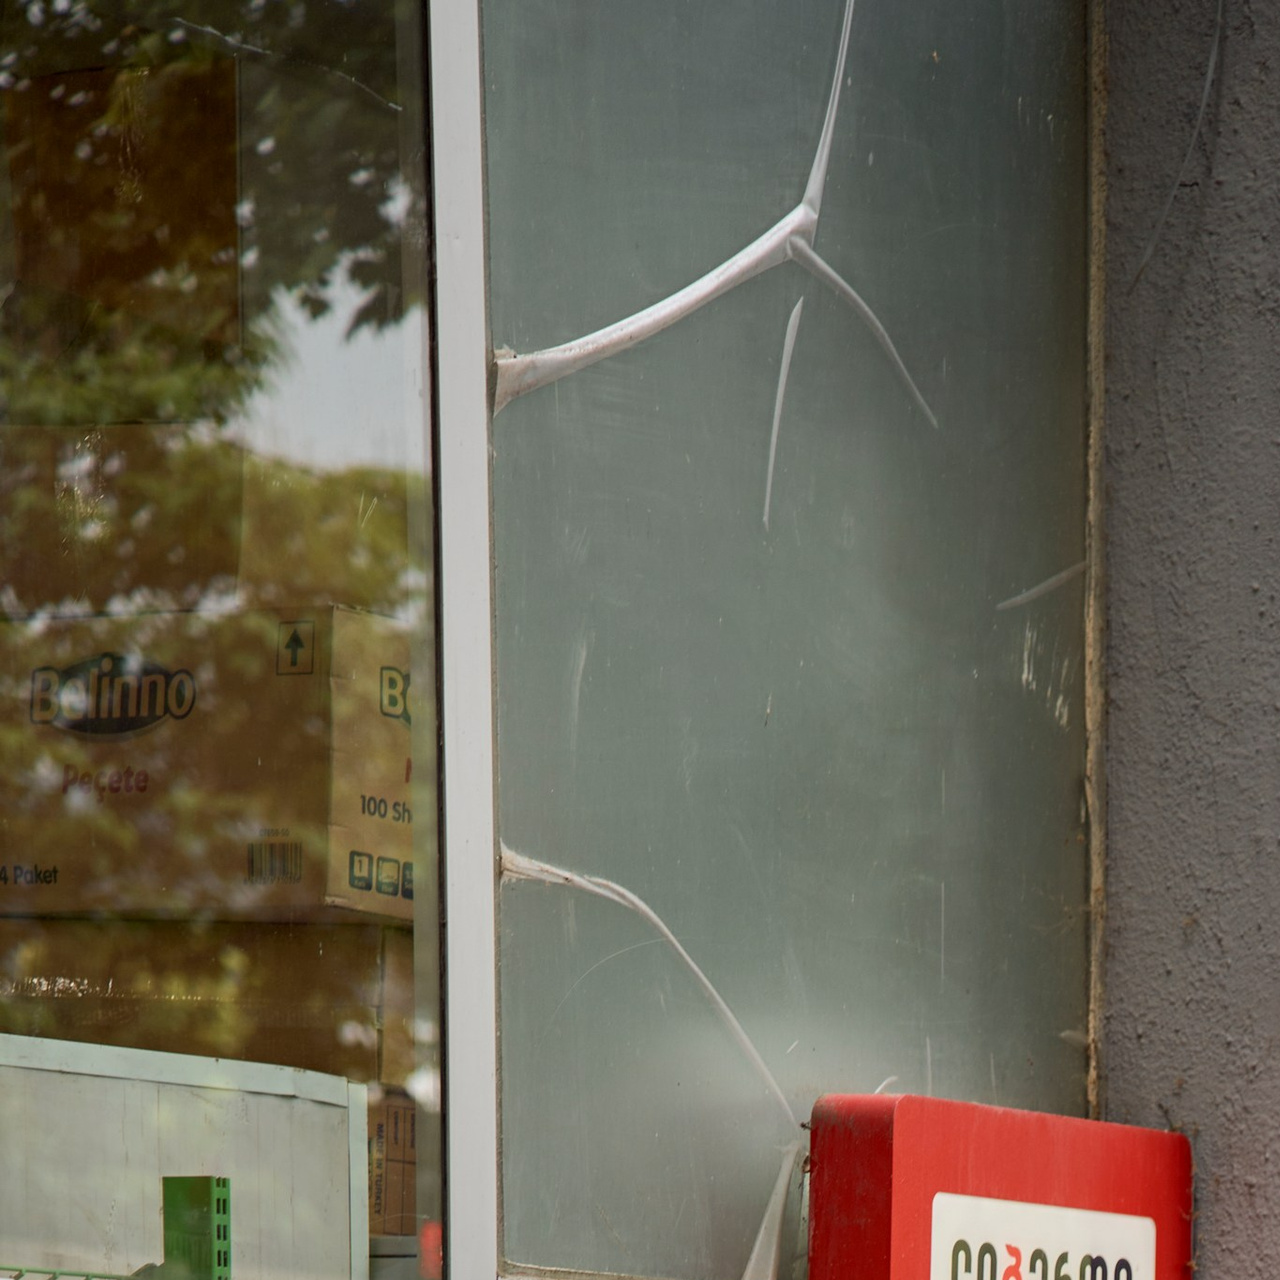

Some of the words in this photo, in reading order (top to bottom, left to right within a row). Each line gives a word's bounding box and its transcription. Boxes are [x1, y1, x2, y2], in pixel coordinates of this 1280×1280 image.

[31, 654, 196, 724] Belinno
[360, 794, 387, 818] 100
[13, 864, 59, 885] Paket
[374, 1172, 383, 1215] TURKEY
